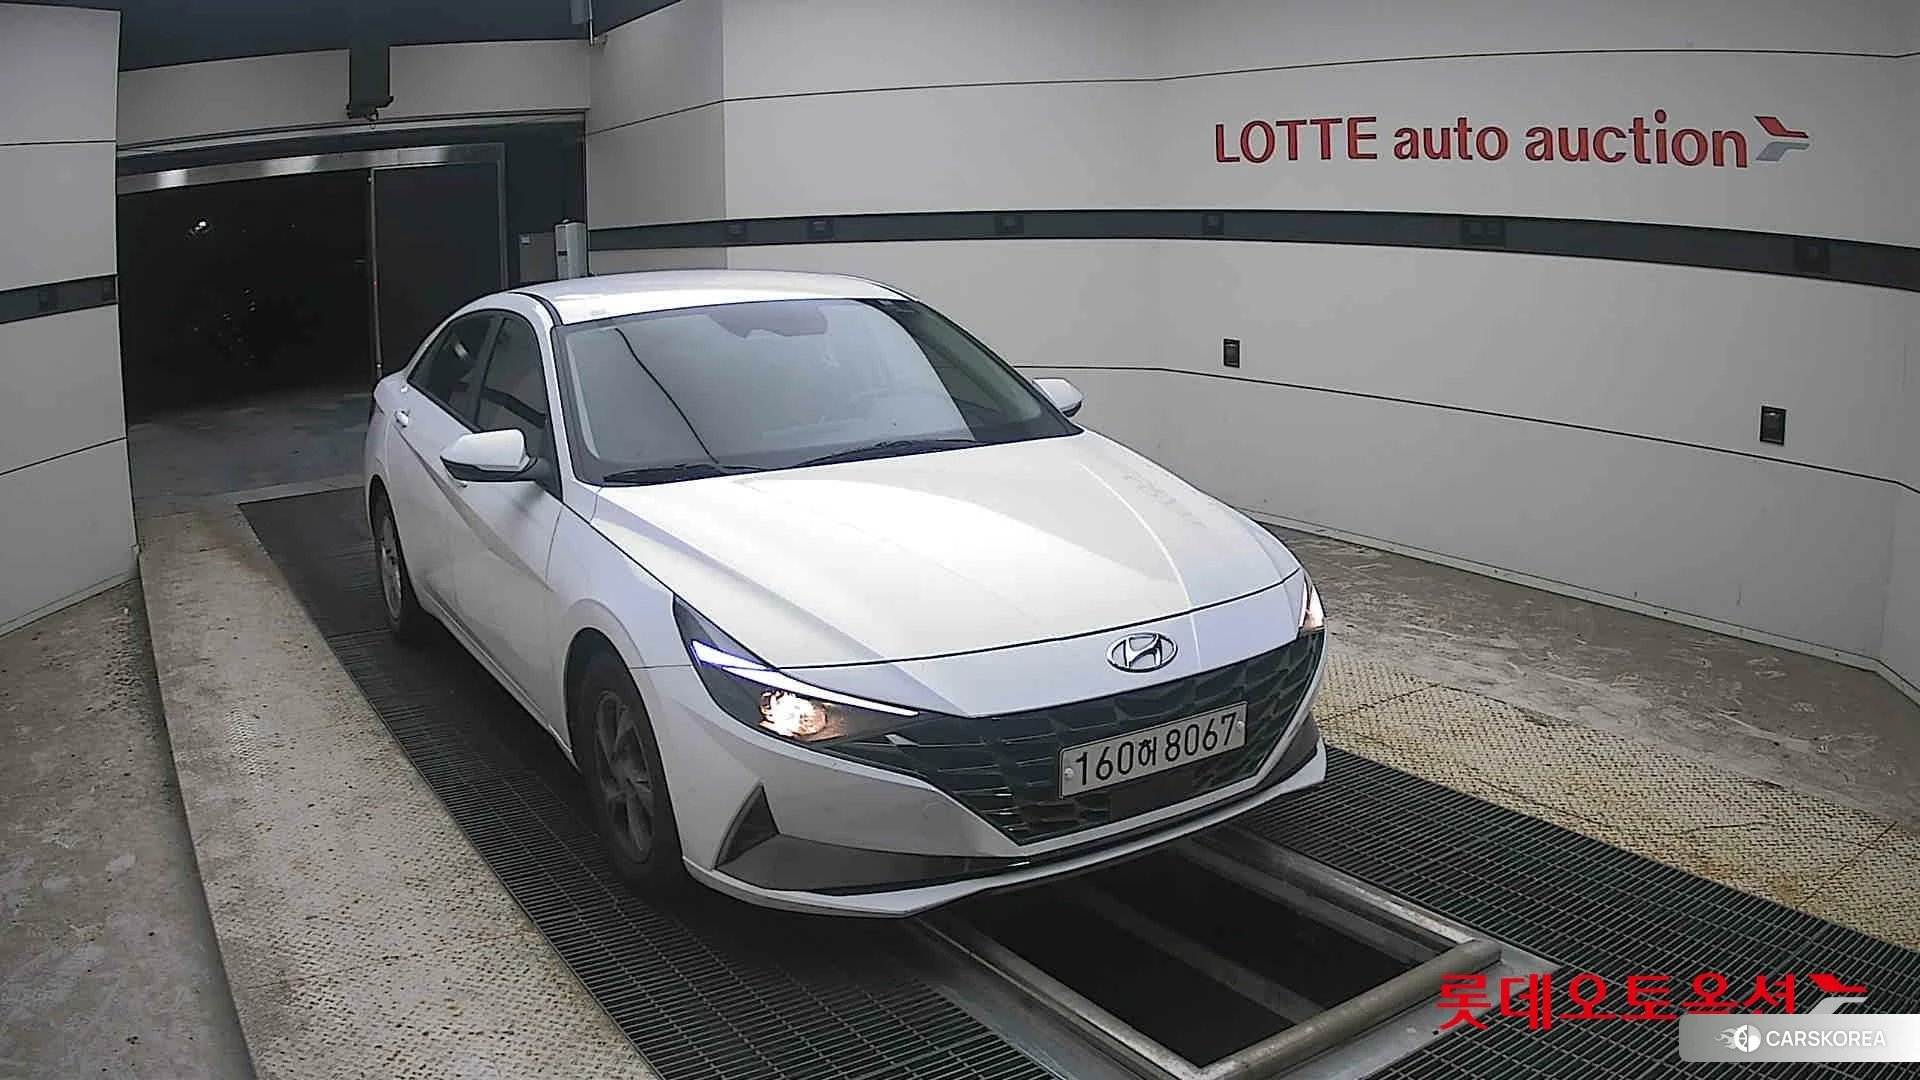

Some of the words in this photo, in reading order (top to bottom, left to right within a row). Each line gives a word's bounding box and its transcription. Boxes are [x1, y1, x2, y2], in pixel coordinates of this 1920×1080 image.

[1214, 115, 1378, 164] LOTTE
[1393, 116, 1509, 162] auto
[1524, 109, 1748, 168] auction
